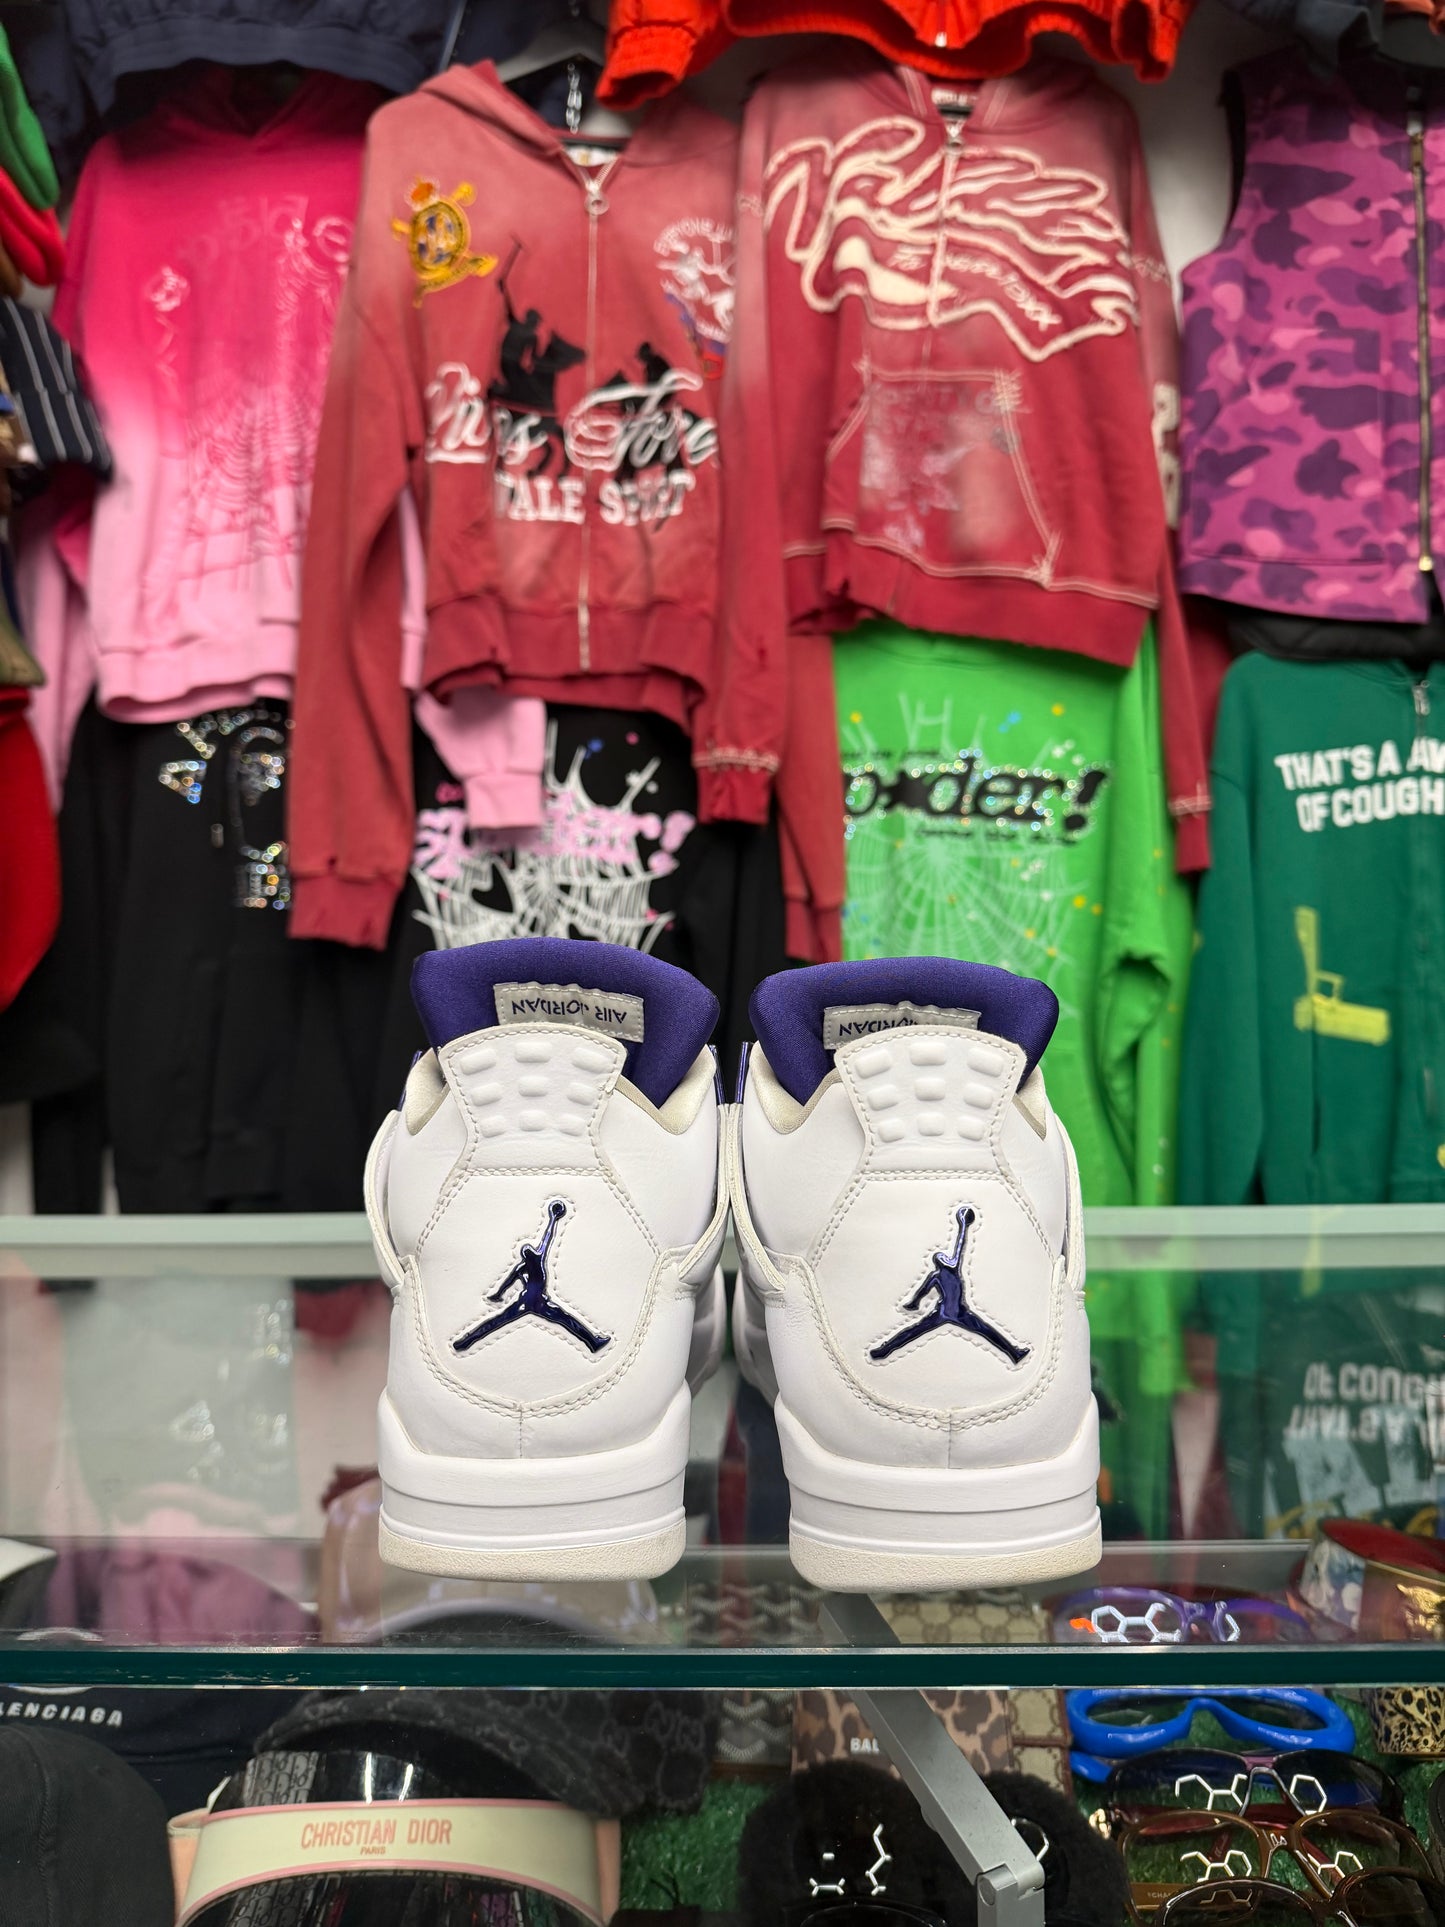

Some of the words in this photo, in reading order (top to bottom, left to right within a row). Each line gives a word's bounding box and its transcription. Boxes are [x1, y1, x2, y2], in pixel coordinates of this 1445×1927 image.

[1274, 745, 1374, 790] THAT'S
[1377, 740, 1401, 777] A
[1296, 792, 1329, 832] OF
[1331, 775, 1445, 828] COUGH
[511, 998, 589, 1015] JORDAN
[595, 1006, 627, 1024] AIR
[0, 1702, 123, 1727] ENCIAGA
[301, 1820, 397, 1849] CHRISTIAN
[407, 1819, 453, 1845] DIOR
[360, 1846, 386, 1855] PARIS
